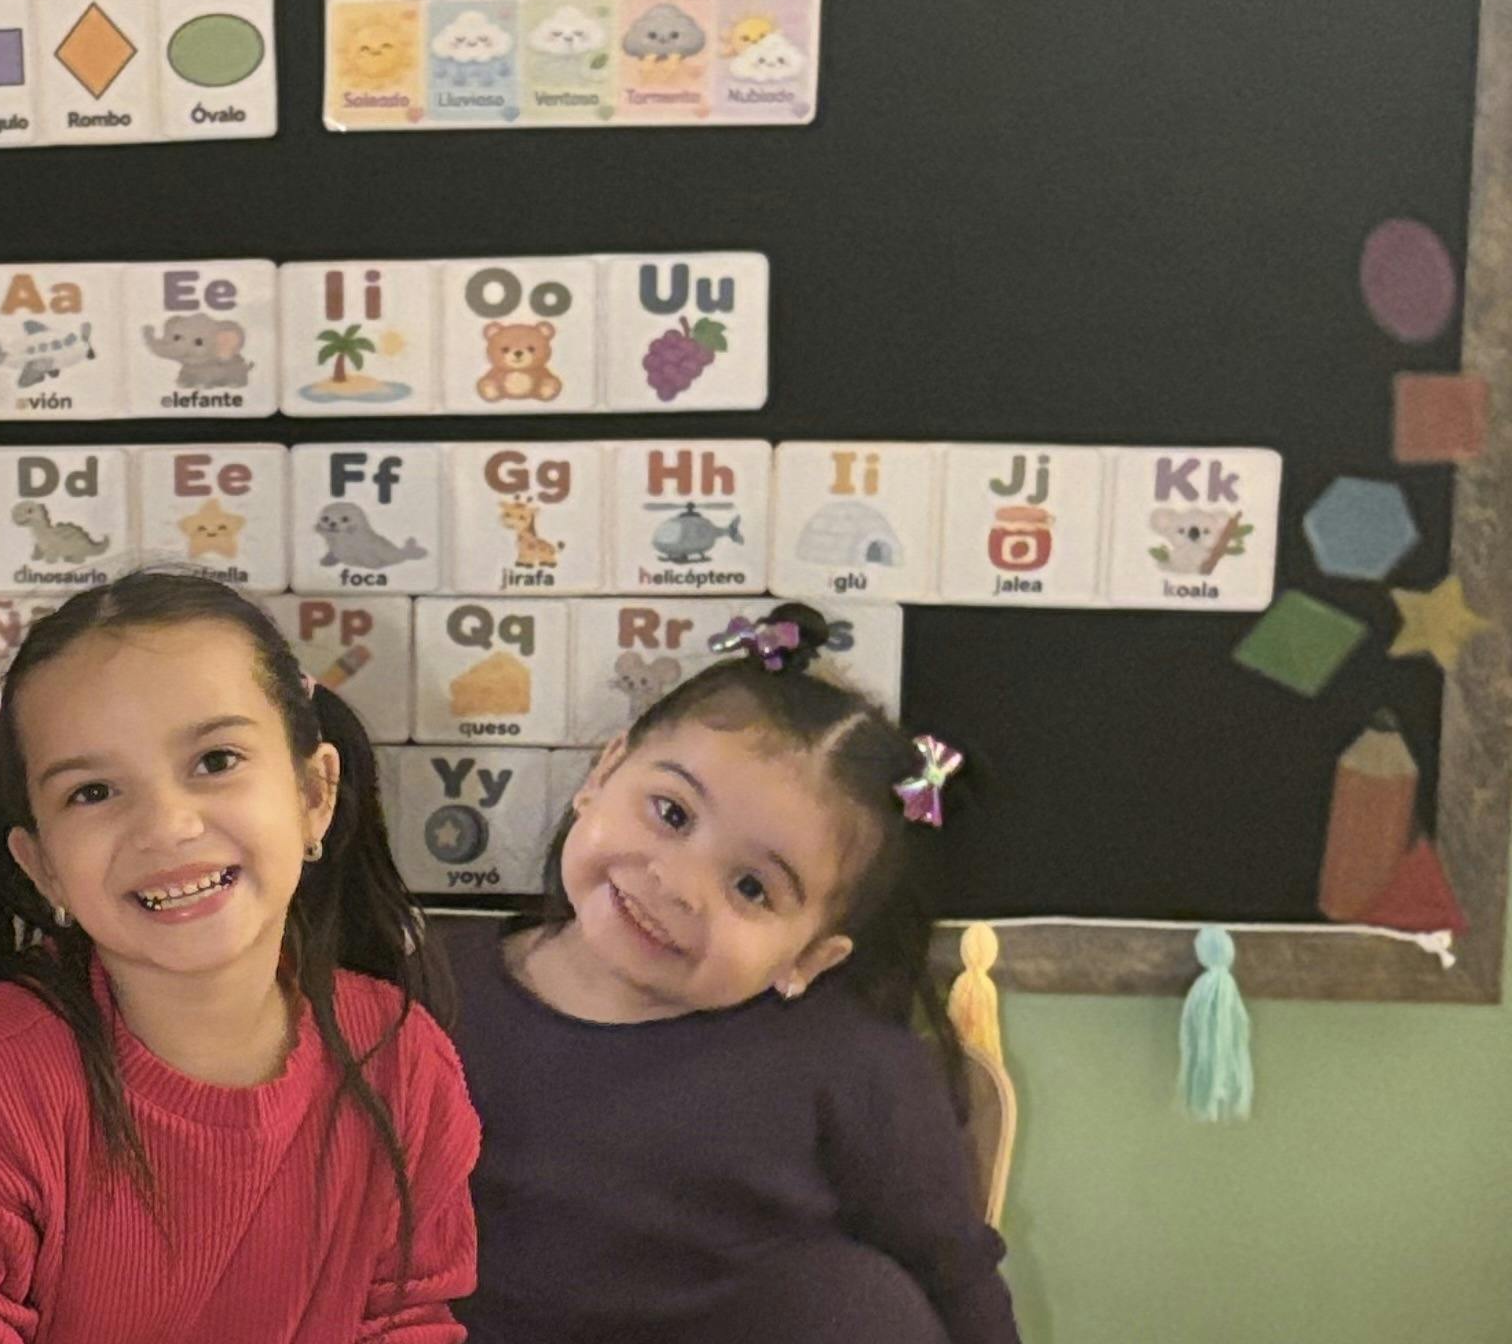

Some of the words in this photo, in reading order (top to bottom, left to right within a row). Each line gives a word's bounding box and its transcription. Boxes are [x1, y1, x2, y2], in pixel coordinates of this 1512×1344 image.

[67, 111, 132, 128] Rombo
[190, 101, 246, 124] Óvalo
[438, 91, 506, 107] Lluvioso
[535, 90, 600, 107] Ventoso
[0, 272, 83, 315] Aa
[163, 269, 238, 312] Ee
[464, 267, 573, 318] Oo
[639, 262, 735, 315] Uu
[15, 392, 73, 411] avión
[160, 390, 243, 409] elefante
[17, 455, 99, 499] Dd
[173, 454, 253, 498] Ee
[329, 452, 403, 505] Ff
[484, 449, 572, 504] Gg
[647, 449, 736, 496] Hh
[830, 451, 880, 495] Ii
[989, 453, 1051, 505] Jj
[1154, 456, 1240, 504] Kk
[13, 564, 107, 585] dinosaurio
[340, 568, 388, 587] foca
[500, 567, 555, 591] jirafa
[638, 567, 746, 589] helicóptero
[993, 574, 1043, 596] jalea
[1162, 578, 1219, 600] koala
[298, 600, 373, 646] Pp
[445, 605, 535, 655] Qq
[618, 606, 694, 650] Rr
[826, 619, 855, 652] s
[459, 720, 521, 739] queso
[431, 756, 514, 809] Yy
[447, 867, 501, 888] yoyó
